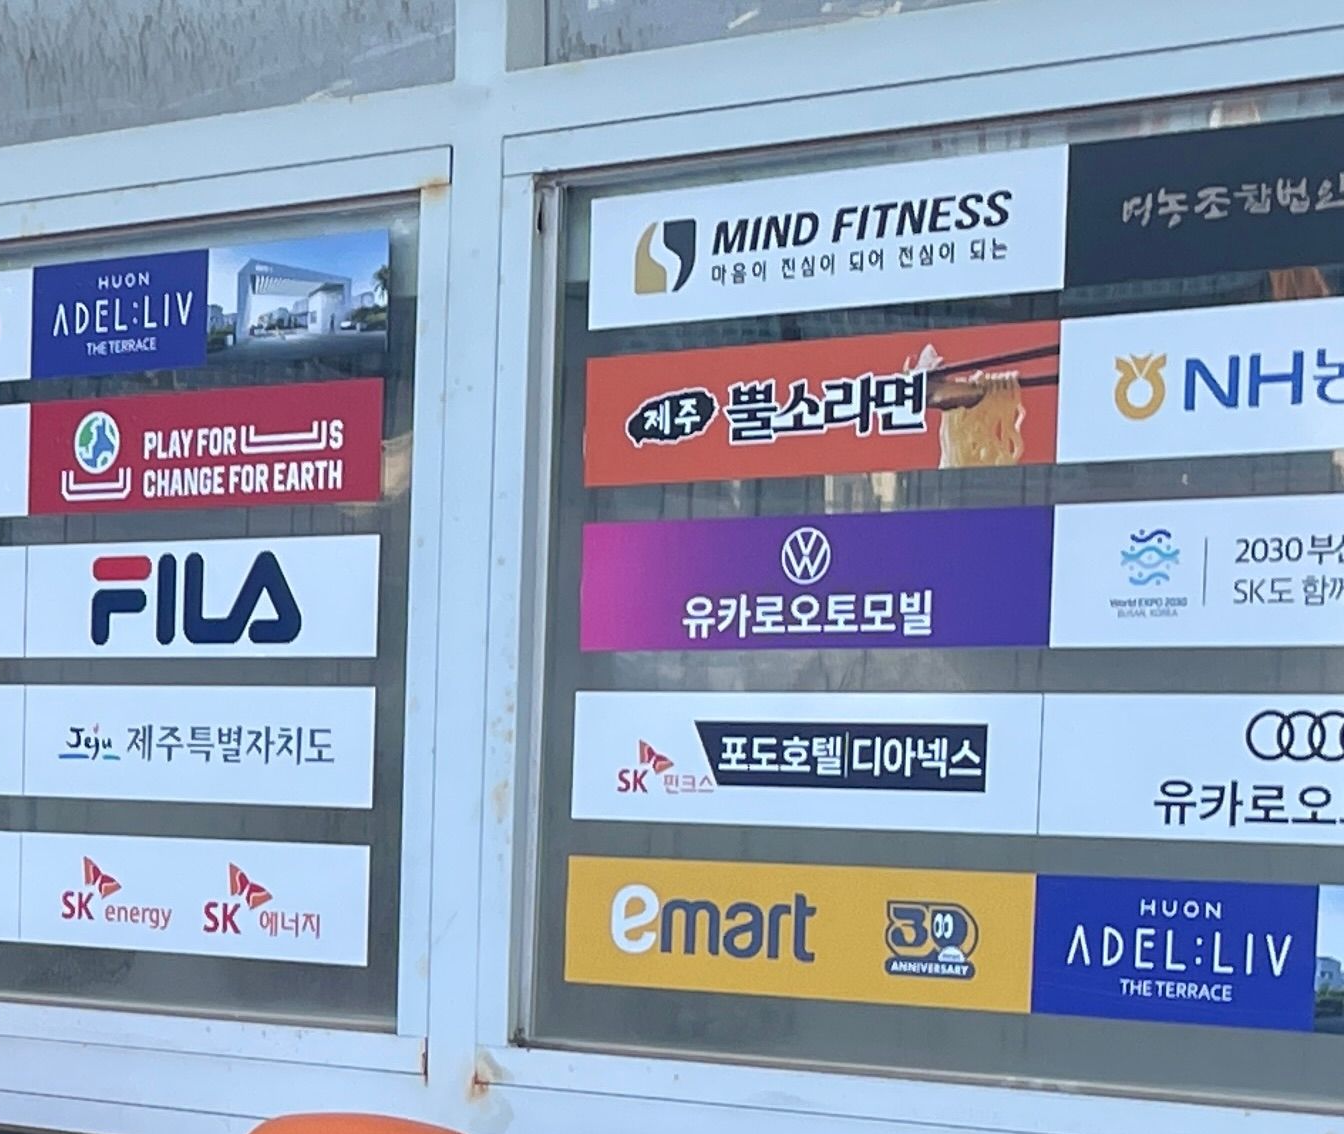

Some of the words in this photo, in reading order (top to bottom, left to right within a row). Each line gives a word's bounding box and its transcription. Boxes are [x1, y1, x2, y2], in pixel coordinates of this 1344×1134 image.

[711, 211, 820, 255] MIND
[831, 190, 1013, 243] FITNESS
[98, 271, 150, 290] HUON
[711, 260, 767, 286] 마음이
[781, 252, 835, 280] 진심이
[849, 247, 884, 272] 되어
[970, 237, 1008, 261] 되는
[86, 341, 108, 356] THE
[108, 337, 157, 354] TERRACE
[643, 398, 701, 435] 제주
[143, 428, 194, 460] PLAY
[197, 426, 237, 457] FOR
[143, 466, 225, 499] CHANGE
[228, 463, 269, 494] FOR
[273, 459, 344, 492] EARTH
[1235, 537, 1304, 564] 2030
[1307, 534, 1344, 565] 부
[91, 550, 302, 646] FILA
[1233, 577, 1295, 605] SK도
[682, 589, 933, 640] 유카로오토모빌
[65, 722, 113, 760] Jeju
[126, 724, 336, 766] 제주특별자치도
[717, 736, 842, 777] 포도호텔
[852, 736, 983, 778] 디아넥스
[617, 769, 648, 793] SK
[1154, 780, 1344, 828] 유카로오
[61, 890, 94, 921] SK
[104, 904, 173, 931] energy
[203, 901, 242, 935] SK
[259, 909, 322, 940] 에너지
[611, 883, 818, 963] emart
[1140, 899, 1223, 919] HUON
[890, 960, 970, 976] ANNIVERSARY
[1120, 978, 1153, 997] THE
[1156, 980, 1233, 1002] TERRACE
